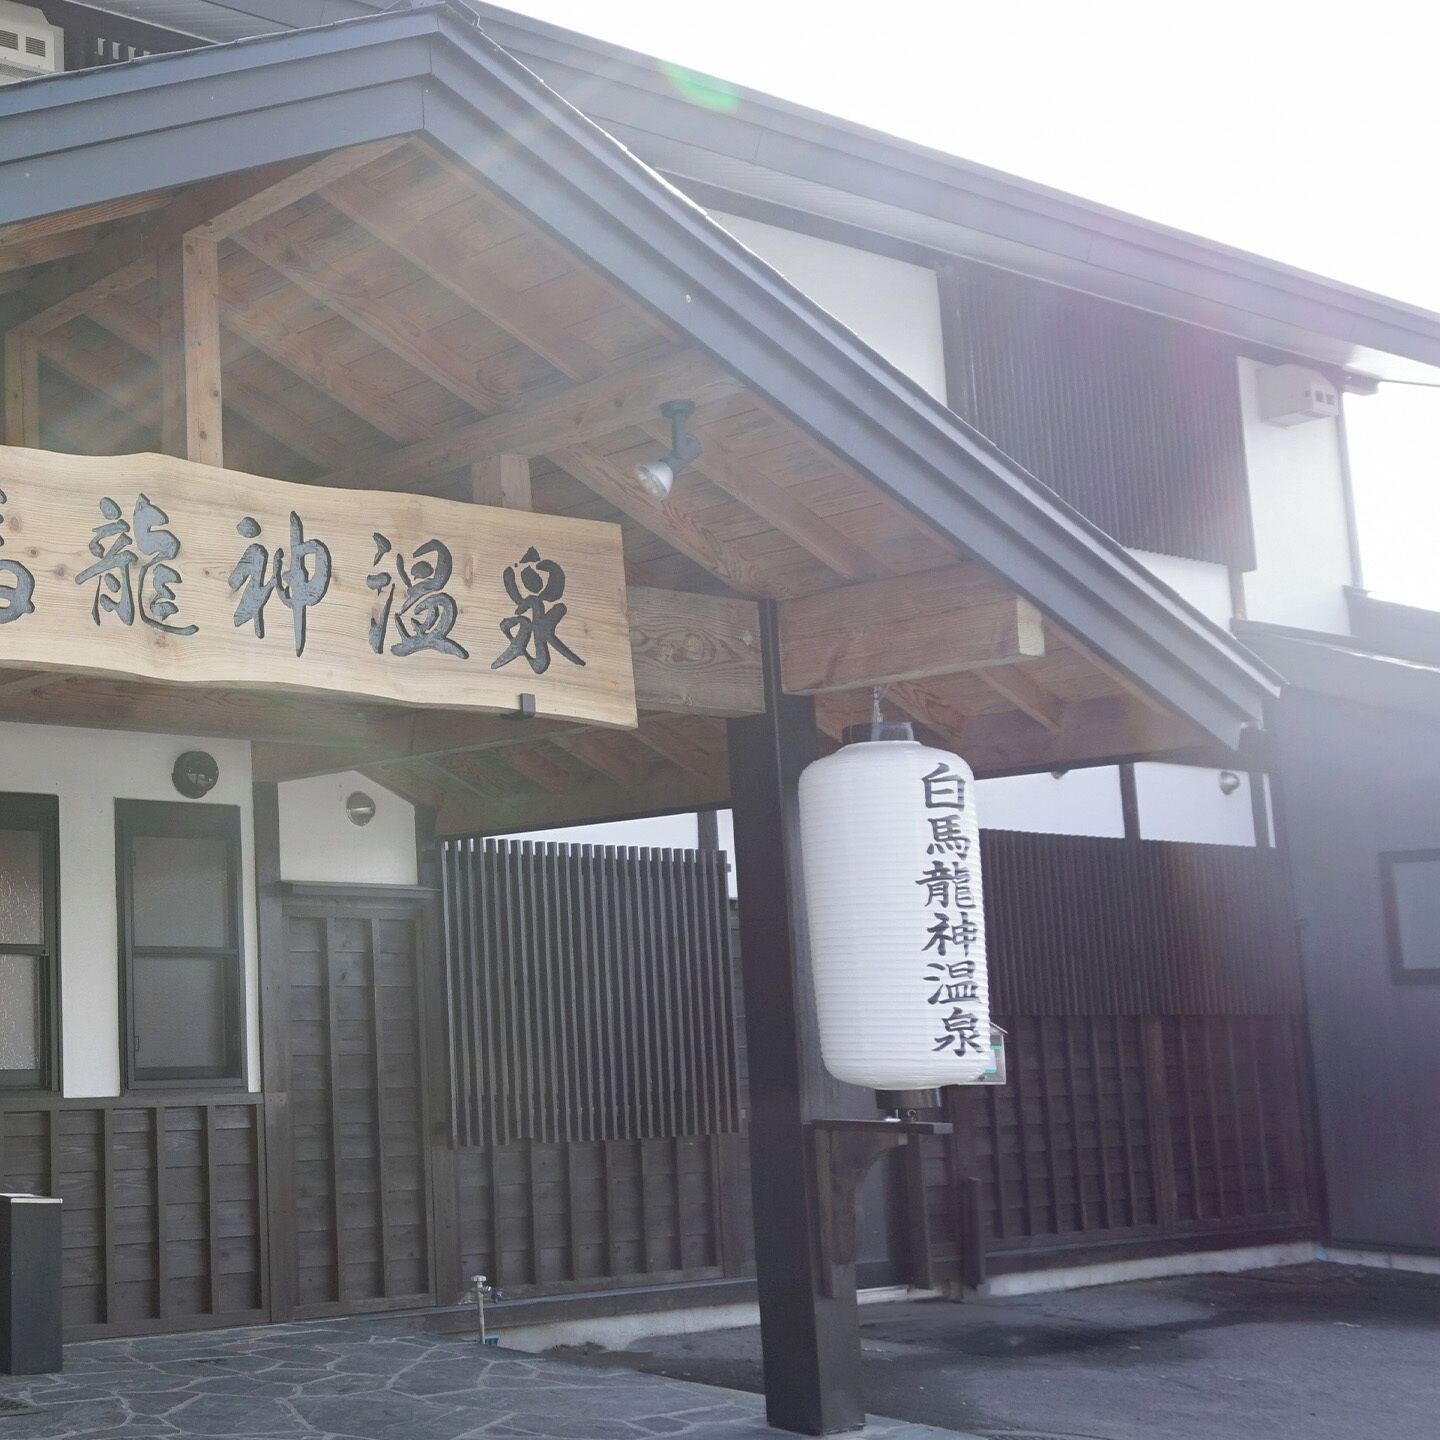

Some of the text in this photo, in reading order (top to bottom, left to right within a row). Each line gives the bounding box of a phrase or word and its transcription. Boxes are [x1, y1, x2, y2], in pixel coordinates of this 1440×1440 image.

[915, 763, 984, 1057] 白馬龍神温泉
